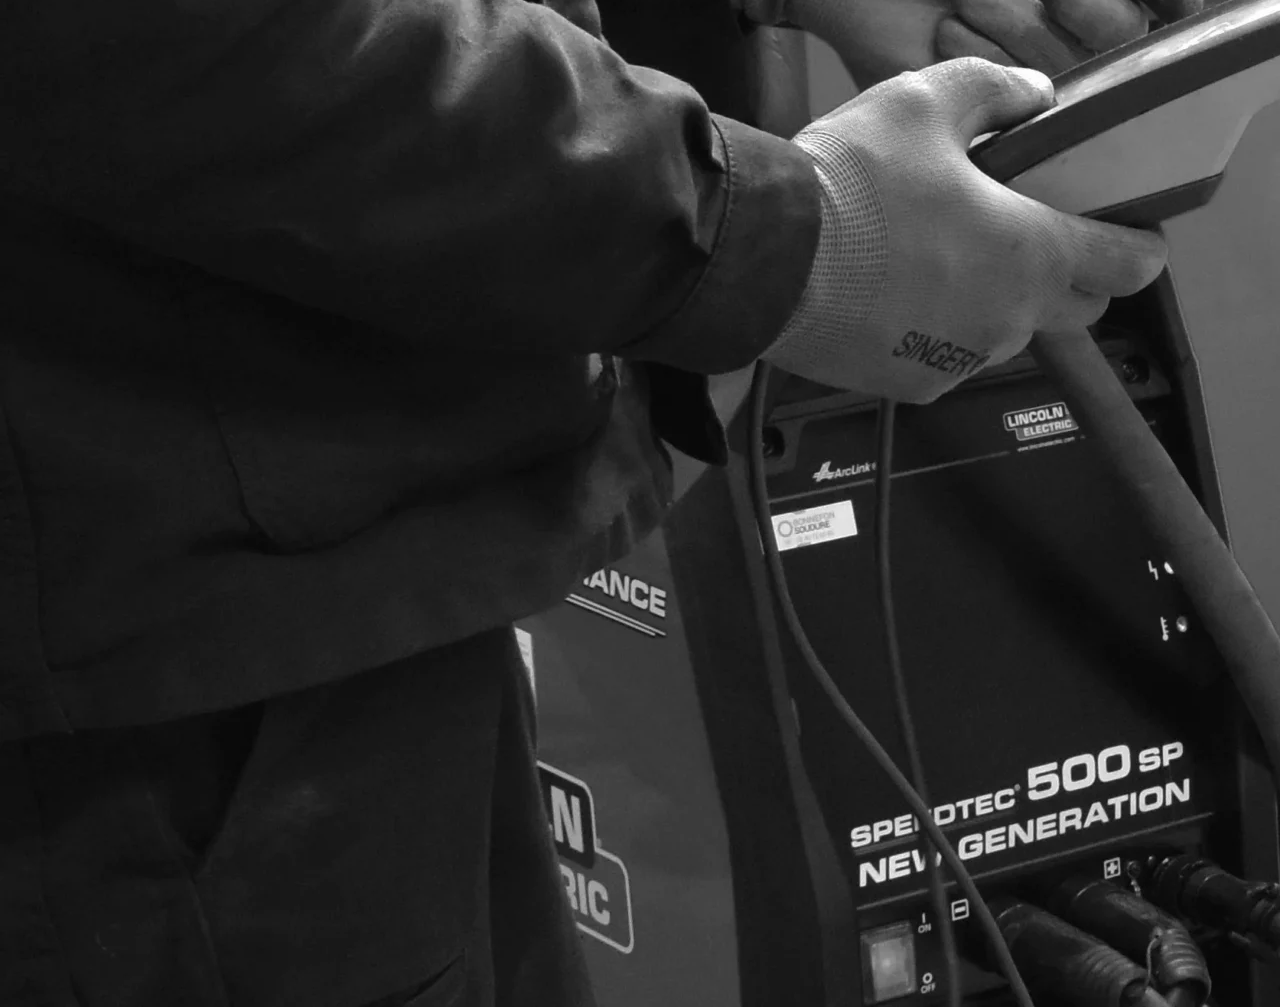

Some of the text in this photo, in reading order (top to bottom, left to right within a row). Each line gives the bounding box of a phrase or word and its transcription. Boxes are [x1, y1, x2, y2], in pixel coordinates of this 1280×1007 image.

[1007, 405, 1063, 428] LINCOLN
[1023, 419, 1072, 437] ELECTRIC
[794, 520, 831, 535] SOUDURE
[584, 569, 666, 617] ANCE
[1027, 744, 1131, 800] 500
[1138, 741, 1184, 773] SP
[958, 778, 1191, 860] GENERATION
[918, 923, 932, 934] ON
[920, 982, 936, 994] OFF
